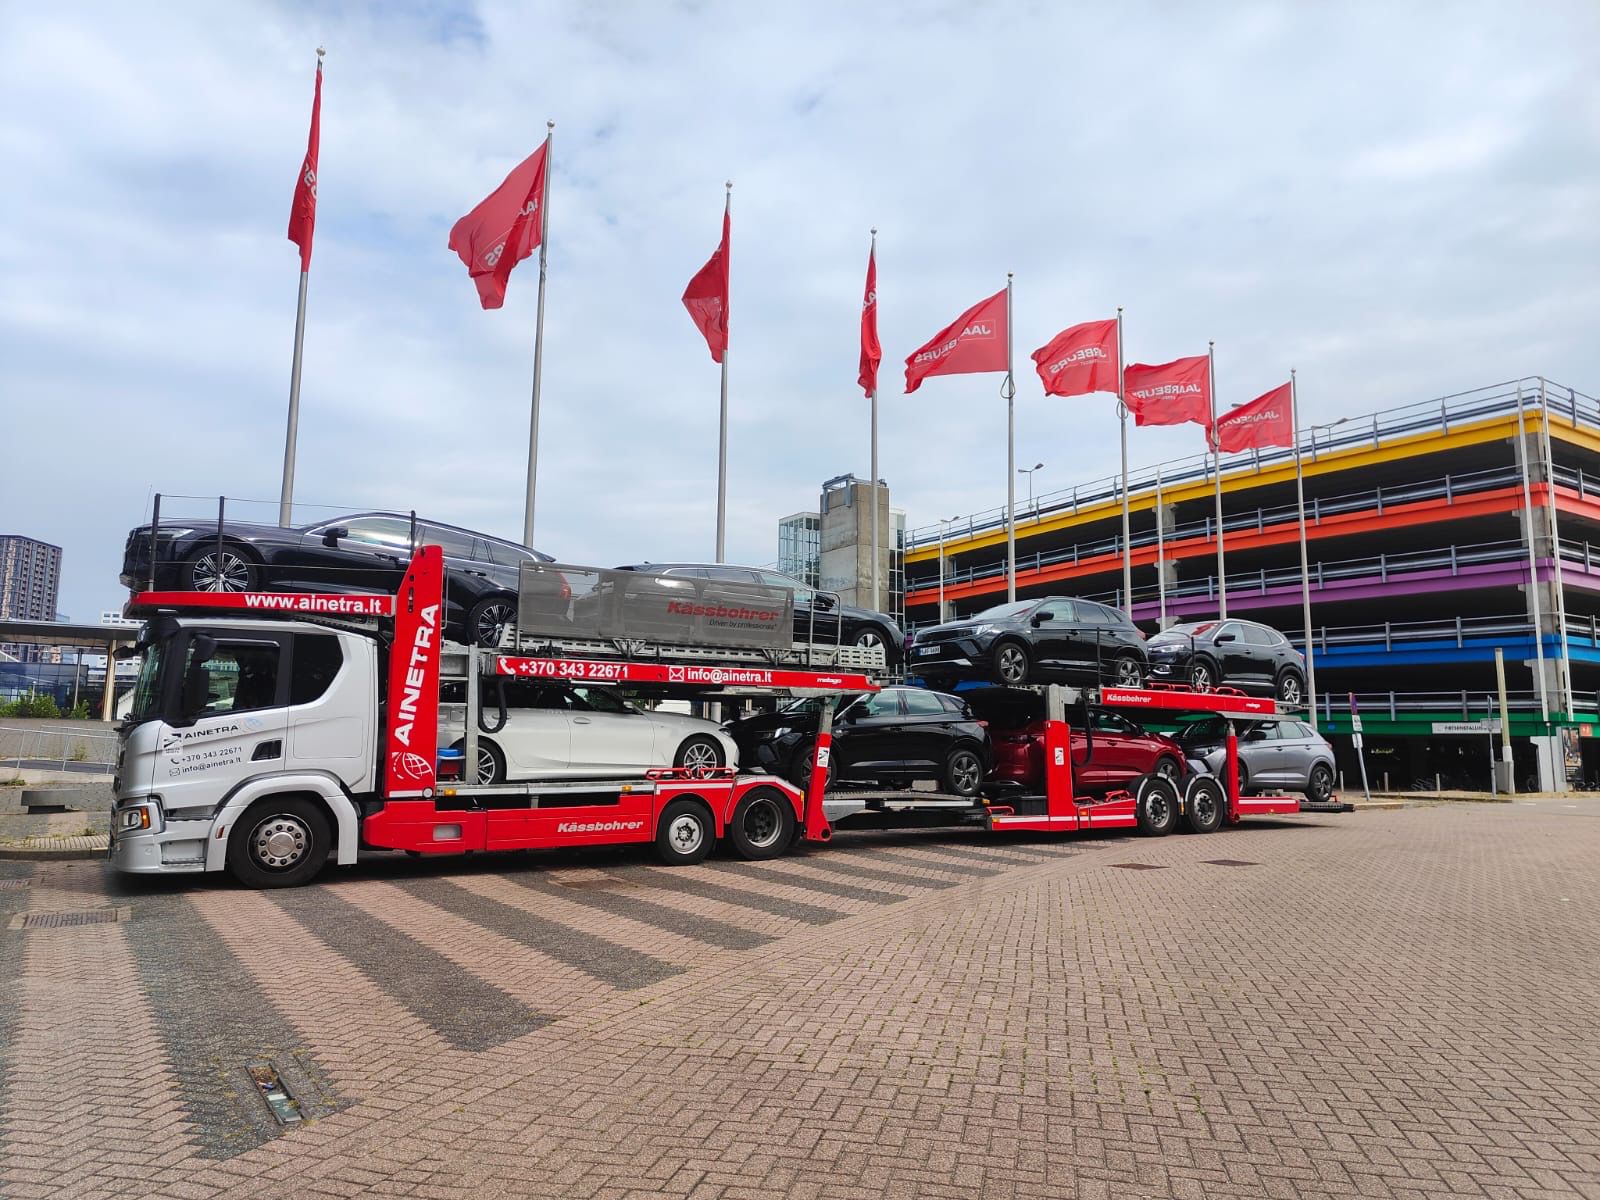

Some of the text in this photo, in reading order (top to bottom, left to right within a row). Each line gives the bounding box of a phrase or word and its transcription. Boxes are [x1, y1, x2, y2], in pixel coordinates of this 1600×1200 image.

[244, 594, 382, 614] www.ainetra.lt
[667, 601, 779, 620] Kässbohrer
[394, 604, 439, 747] AINETRA
[519, 660, 629, 678] +370 343 22671
[687, 668, 772, 684] info@ainetra.lt
[184, 725, 239, 739] AINETRA
[182, 747, 242, 762] +370 343 22671
[182, 757, 242, 773] info@ainetra.lt
[557, 820, 644, 833] Kässbohrer
